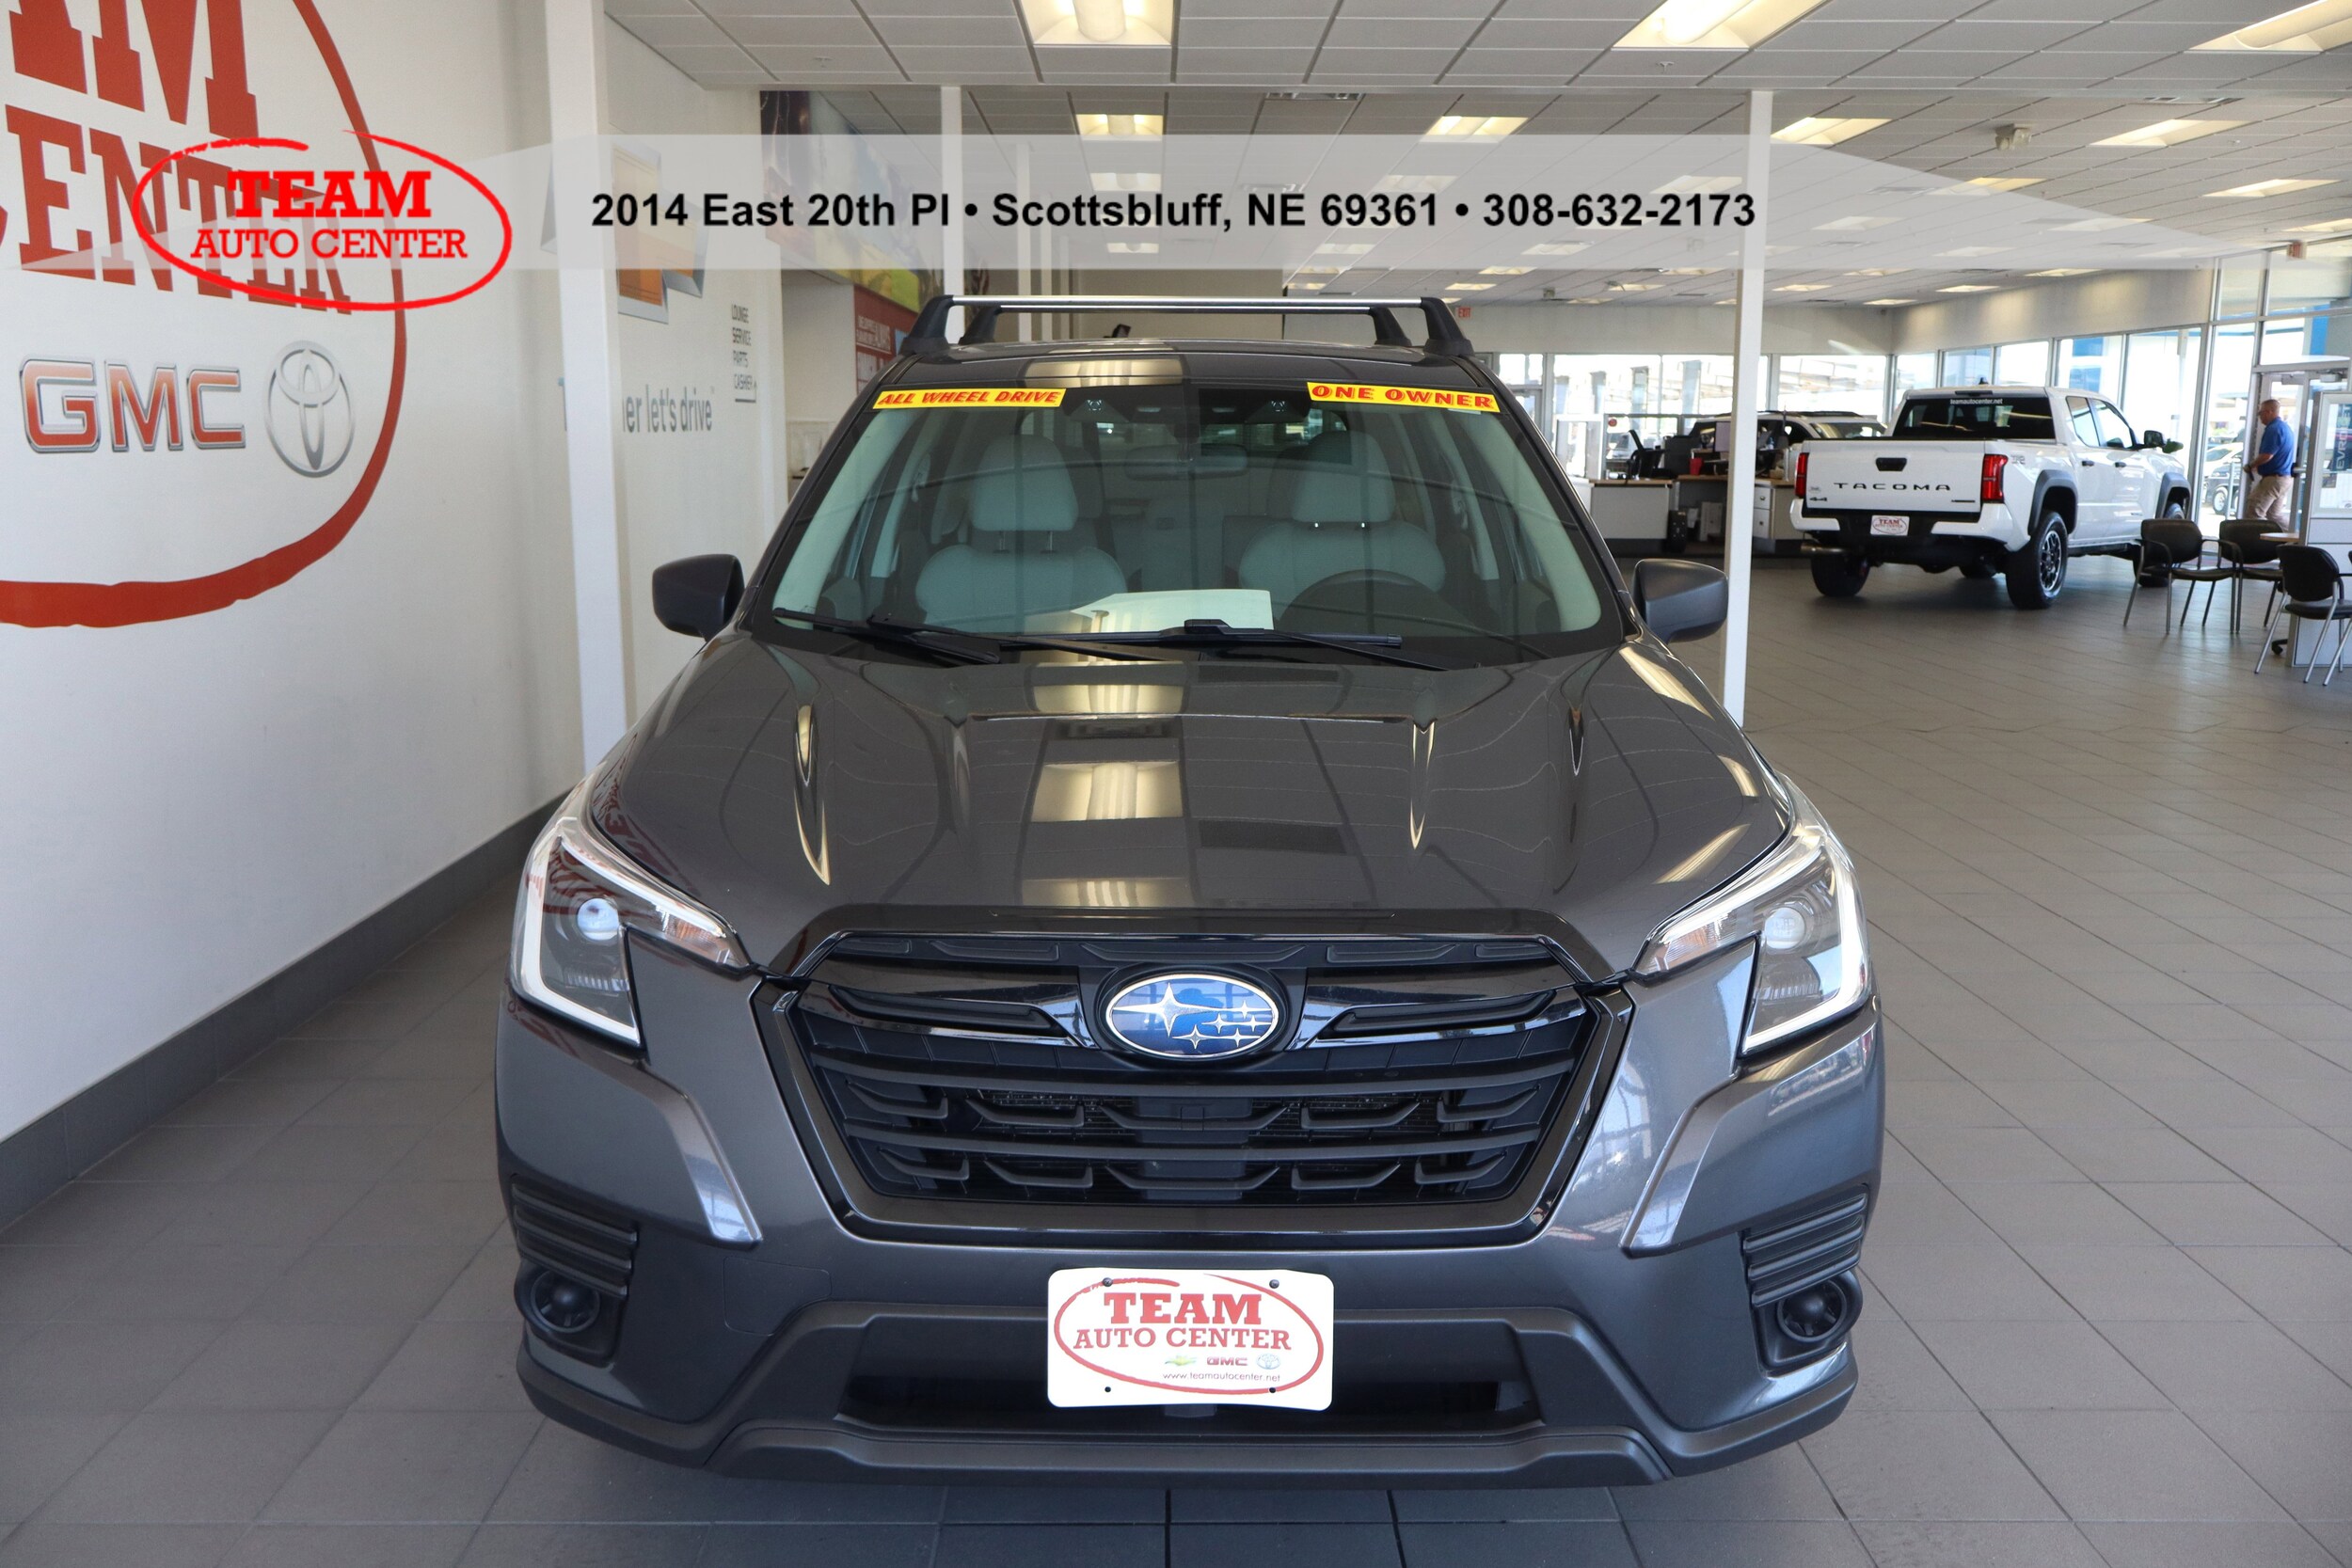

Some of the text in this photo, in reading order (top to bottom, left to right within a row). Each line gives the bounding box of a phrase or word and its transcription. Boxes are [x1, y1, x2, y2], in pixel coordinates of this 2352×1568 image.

[0, 103, 352, 315] ENTER
[19, 357, 246, 454] GMC
[880, 390, 1061, 404] ALL WHEEL DRIVE
[1311, 385, 1493, 407] ONE OWNER
[645, 384, 677, 433] let's
[680, 387, 712, 432] drive
[1833, 482, 1952, 491] TACOMA
[1104, 1292, 1263, 1325] TEAM
[1073, 1327, 1292, 1351] AUTO CENTER
[1206, 1356, 1248, 1367] GMC
[1162, 1371, 1280, 1383] www.teamautocenter.net
